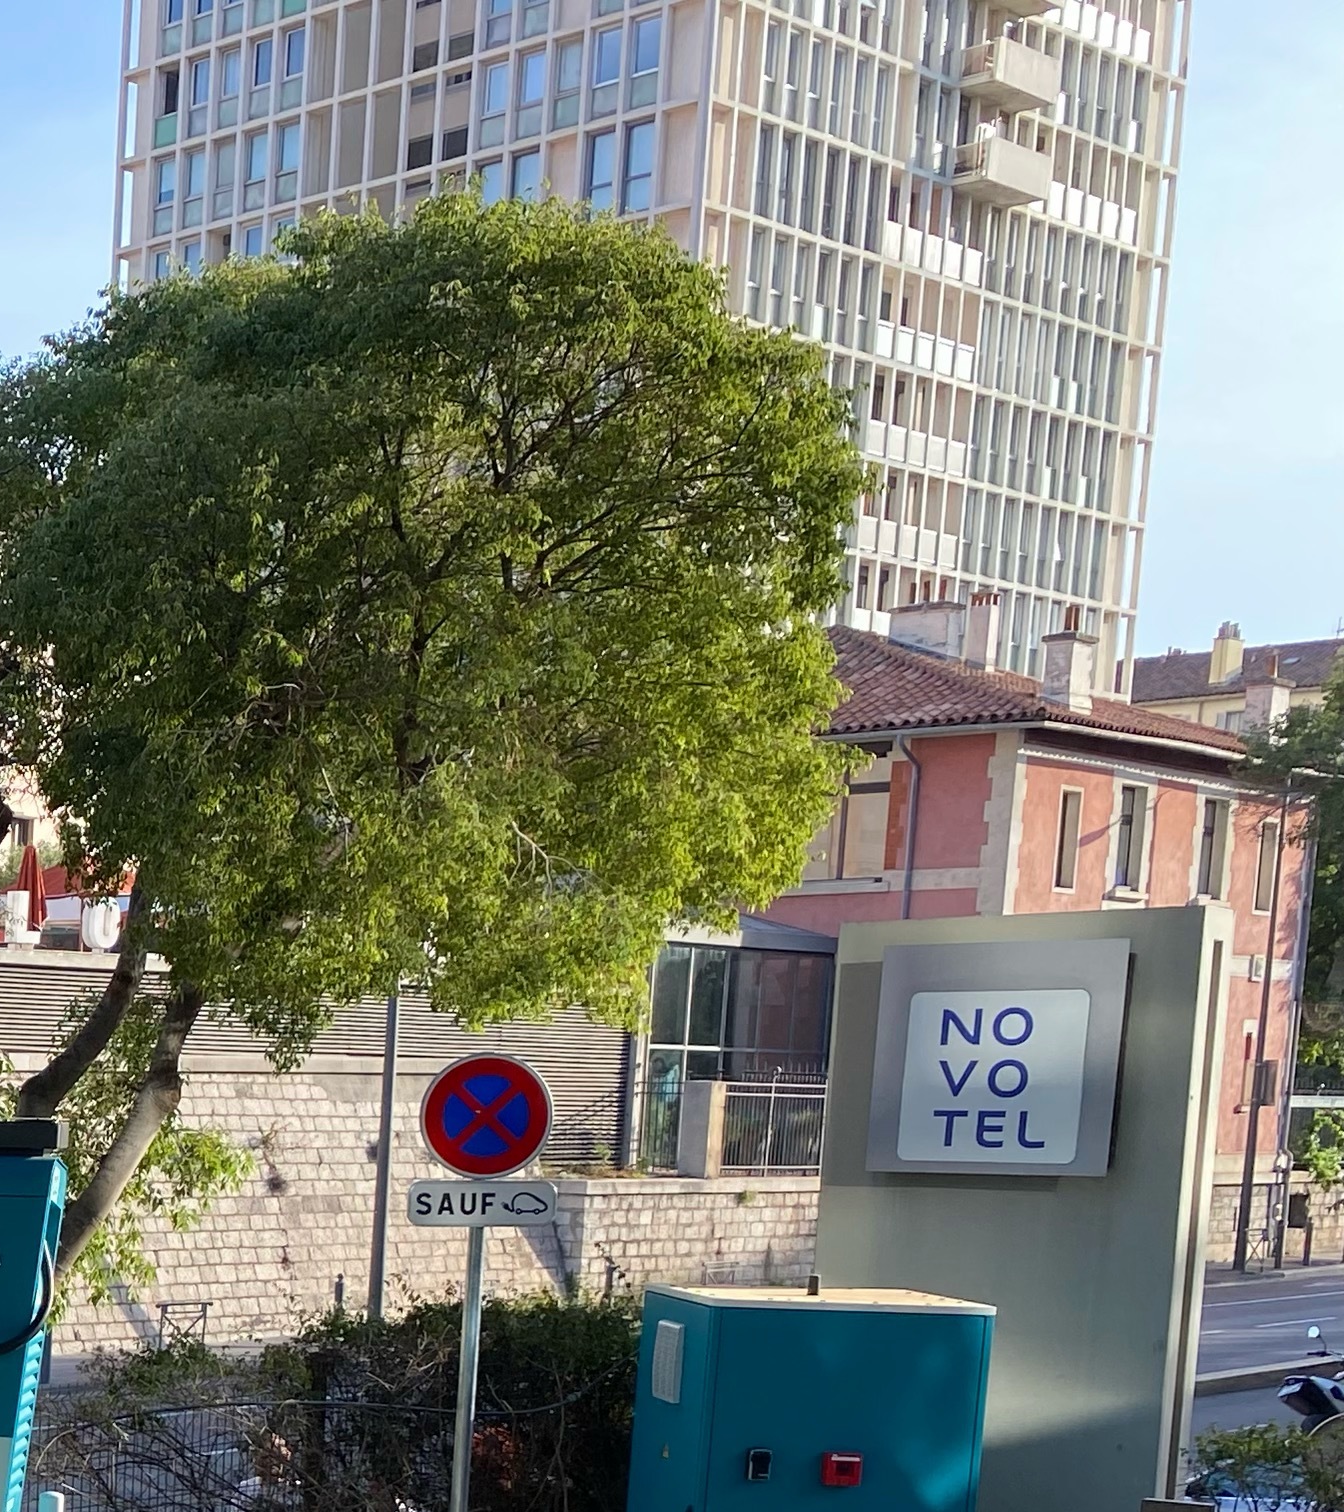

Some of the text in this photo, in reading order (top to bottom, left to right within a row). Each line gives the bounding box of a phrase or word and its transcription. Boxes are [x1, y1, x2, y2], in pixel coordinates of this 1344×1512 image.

[940, 1007, 1034, 1046] NO
[939, 1059, 1029, 1098] VO
[933, 1110, 1045, 1149] TEL
[416, 1192, 496, 1215] SAUF
